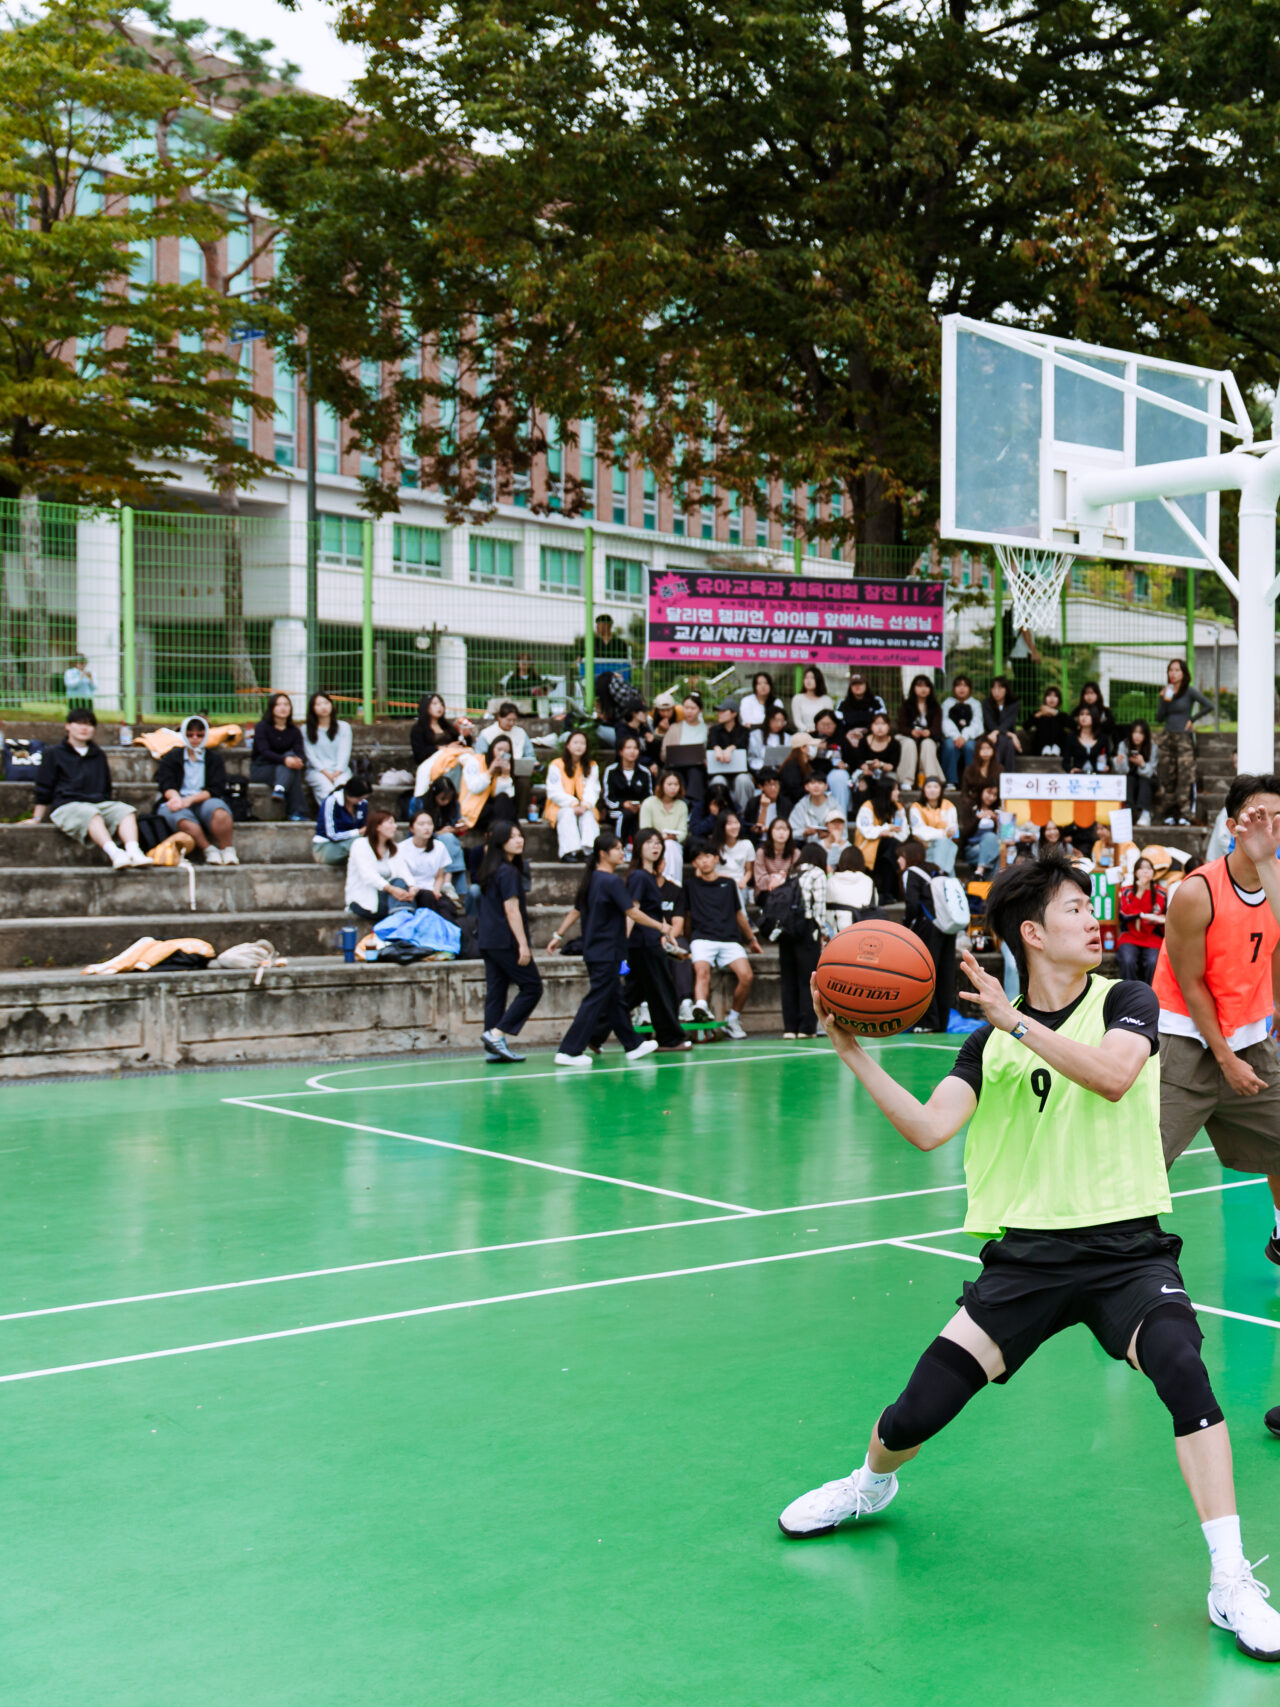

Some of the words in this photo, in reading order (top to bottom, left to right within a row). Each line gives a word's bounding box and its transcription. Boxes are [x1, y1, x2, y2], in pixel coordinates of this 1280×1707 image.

[696, 577, 785, 597] 유아교육과
[790, 581, 859, 600] 체육대회
[666, 607, 713, 624] 달리면
[718, 609, 769, 626] 챔피언,
[774, 611, 819, 627] 아이들
[824, 613, 884, 629] 앞에서는
[889, 615, 932, 631] 선생님
[679, 646, 700, 656] 아이
[702, 646, 722, 657] 사랑
[724, 647, 744, 658] 백만
[758, 648, 787, 659] 선생님
[790, 649, 809, 660] 모임
[1250, 932, 1263, 963] 7
[827, 979, 901, 1001] EVOLUTION
[1030, 1068, 1052, 1113] 9
